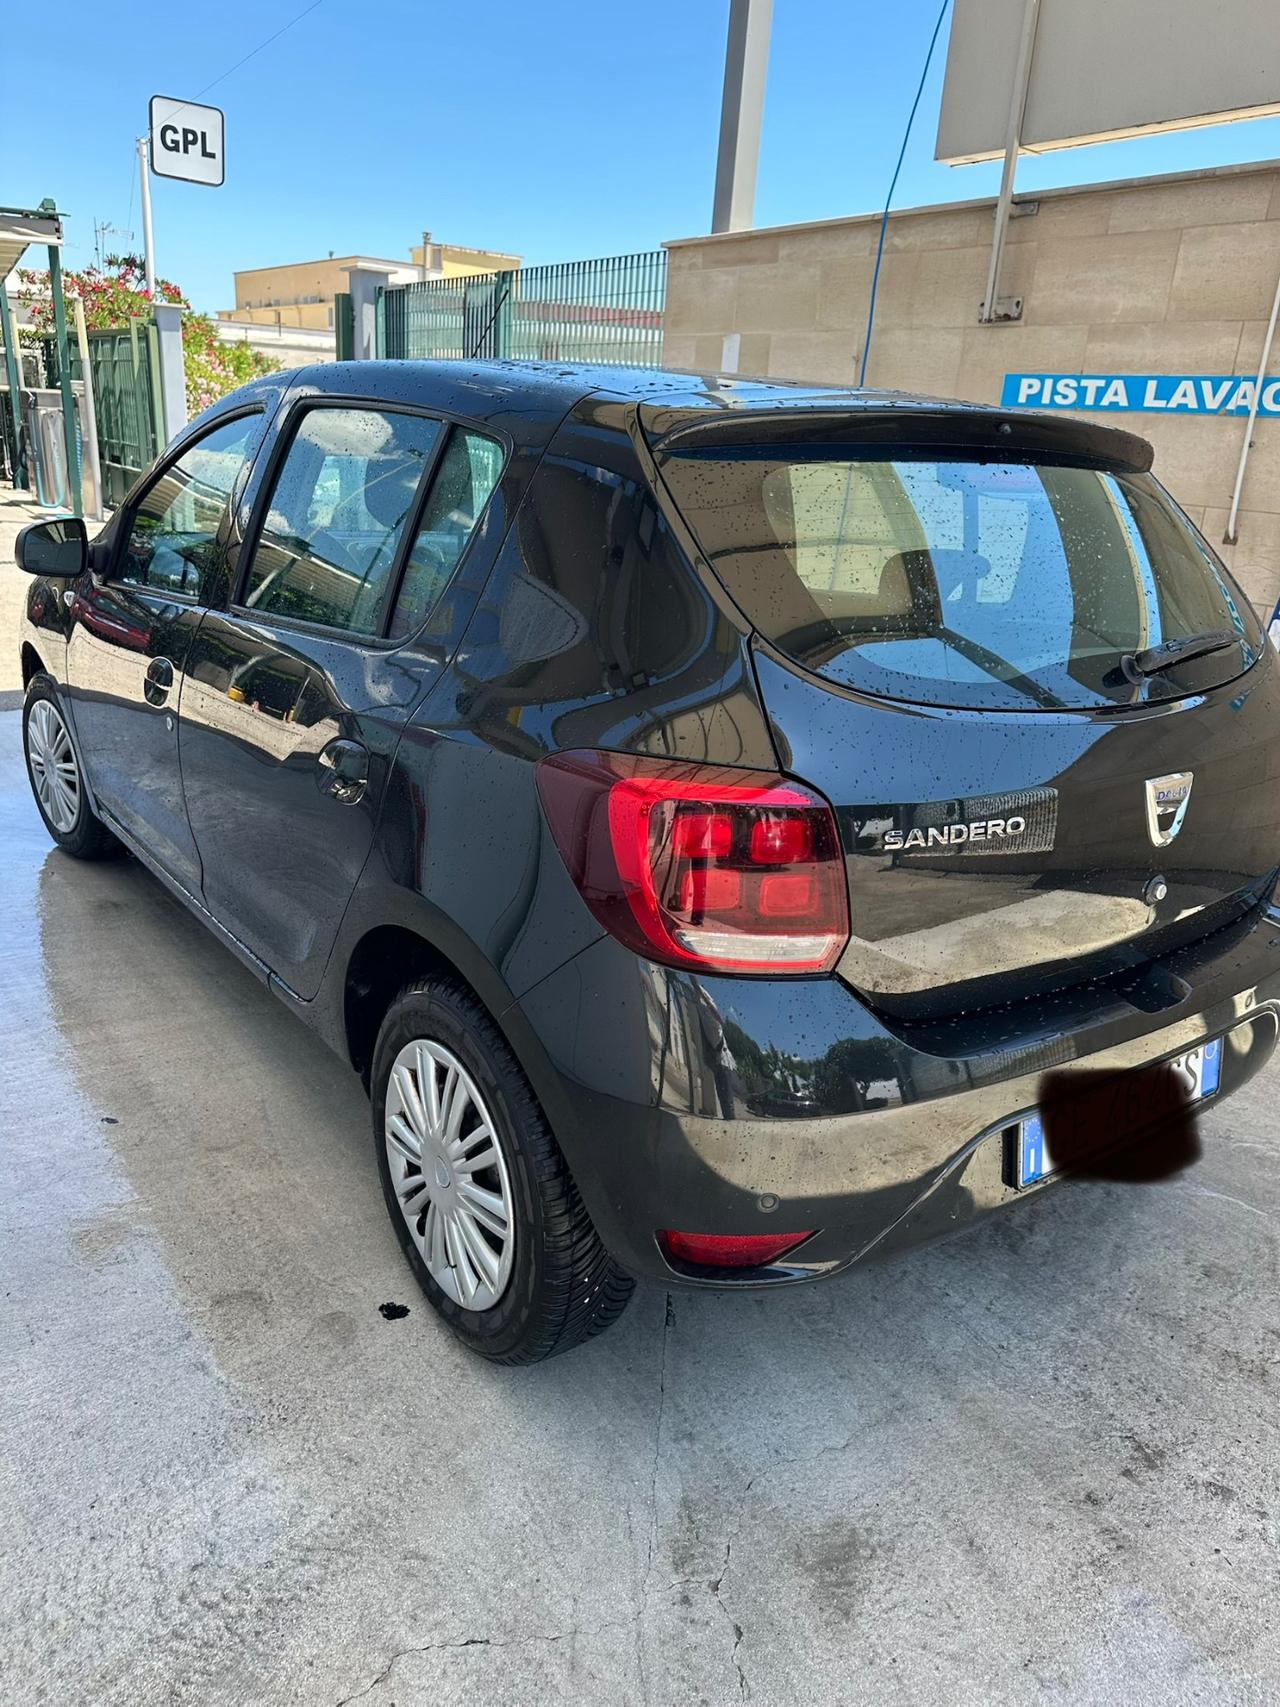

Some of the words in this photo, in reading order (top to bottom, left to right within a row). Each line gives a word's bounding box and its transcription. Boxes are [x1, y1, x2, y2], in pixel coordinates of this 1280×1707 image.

[160, 124, 216, 159] GPL
[1017, 378, 1129, 406] PISTA
[883, 816, 1026, 850] SANDERO
